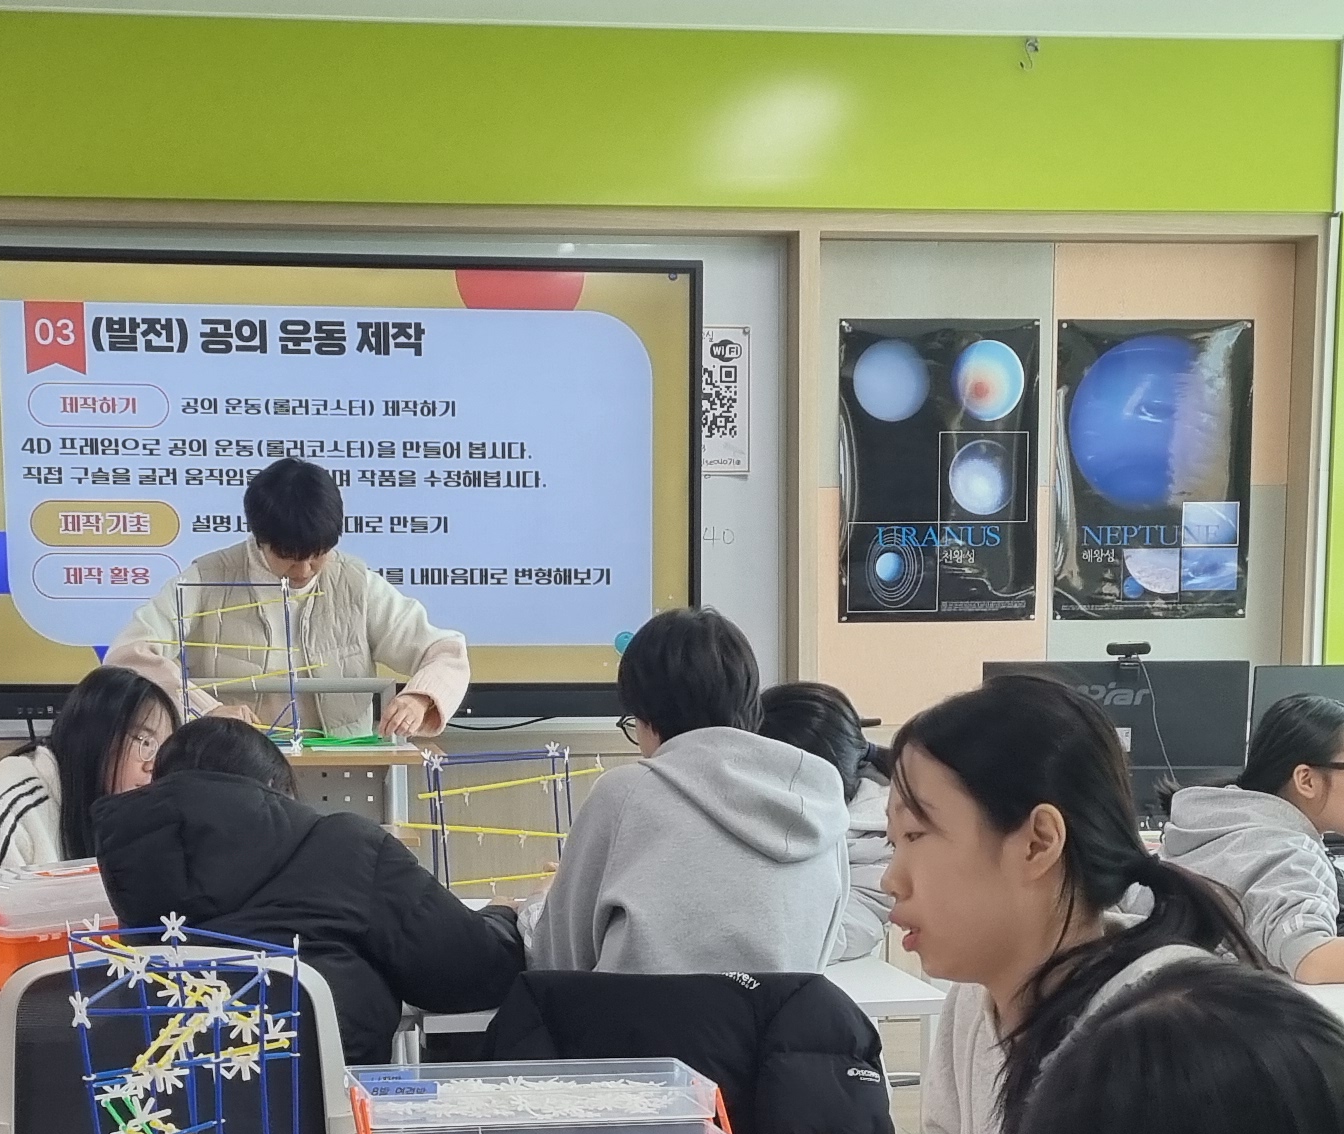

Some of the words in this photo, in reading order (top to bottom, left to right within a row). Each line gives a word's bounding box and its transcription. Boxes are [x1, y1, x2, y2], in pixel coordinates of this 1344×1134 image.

[34, 319, 75, 346] 03
[92, 317, 189, 353] (발전)
[199, 318, 268, 353] 공의
[278, 320, 347, 355] 운동
[356, 320, 425, 357] 제작
[703, 331, 714, 342] 실
[60, 396, 137, 414] 제작하기
[181, 397, 217, 415] 공의
[225, 397, 374, 416] 운동(롤러코스터)
[382, 400, 456, 418] 제작하기
[21, 437, 52, 454] 4D
[59, 437, 161, 456] 프레임으로
[168, 438, 207, 457] 공의
[402, 440, 461, 459] 만들어
[468, 442, 532, 460] 봅시다.
[23, 466, 63, 484] 직접
[70, 467, 131, 485] 구슬을
[138, 467, 177, 485] 굴려
[334, 470, 350, 487] 며
[358, 470, 416, 488] 작품을
[424, 470, 546, 488] 수정해봅시다.
[60, 513, 101, 534] 제작
[108, 512, 150, 534] 기초
[344, 516, 383, 534] 대로
[390, 516, 448, 534] 만들기
[876, 526, 1000, 547] URANUS
[1082, 525, 1219, 546] NEPTUNE
[942, 550, 975, 564] 천왕성
[1082, 549, 1115, 562] 해왕성
[64, 567, 103, 585] 제작
[110, 567, 150, 585] 활용
[410, 568, 508, 586] 내마음대로
[514, 568, 612, 586] 변형해보기
